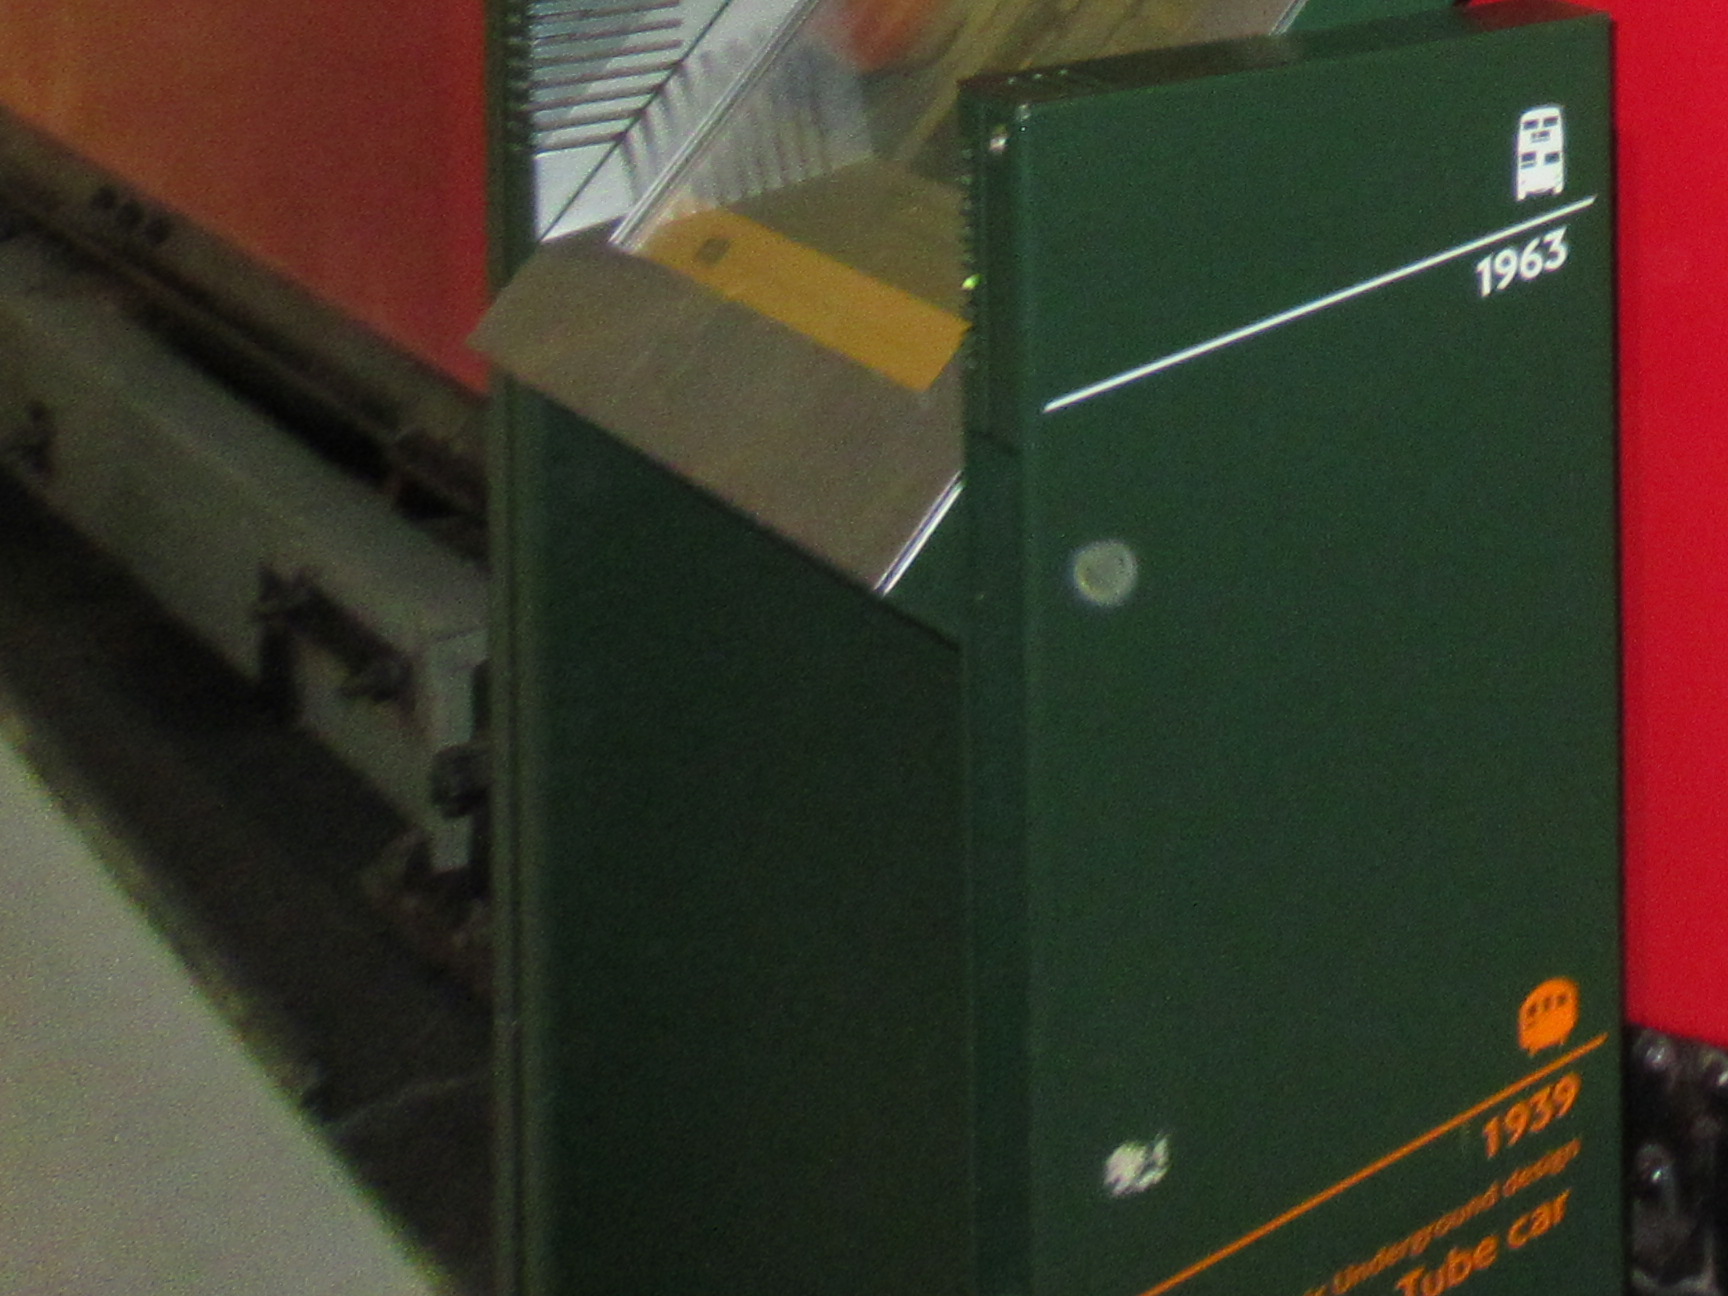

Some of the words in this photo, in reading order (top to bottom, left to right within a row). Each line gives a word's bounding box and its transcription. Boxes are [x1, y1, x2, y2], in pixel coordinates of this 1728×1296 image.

[1476, 226, 1568, 297] 1963
[1483, 1073, 1580, 1158] 1939
[1394, 1234, 1499, 1296] Tube
[1506, 1188, 1571, 1250] car
